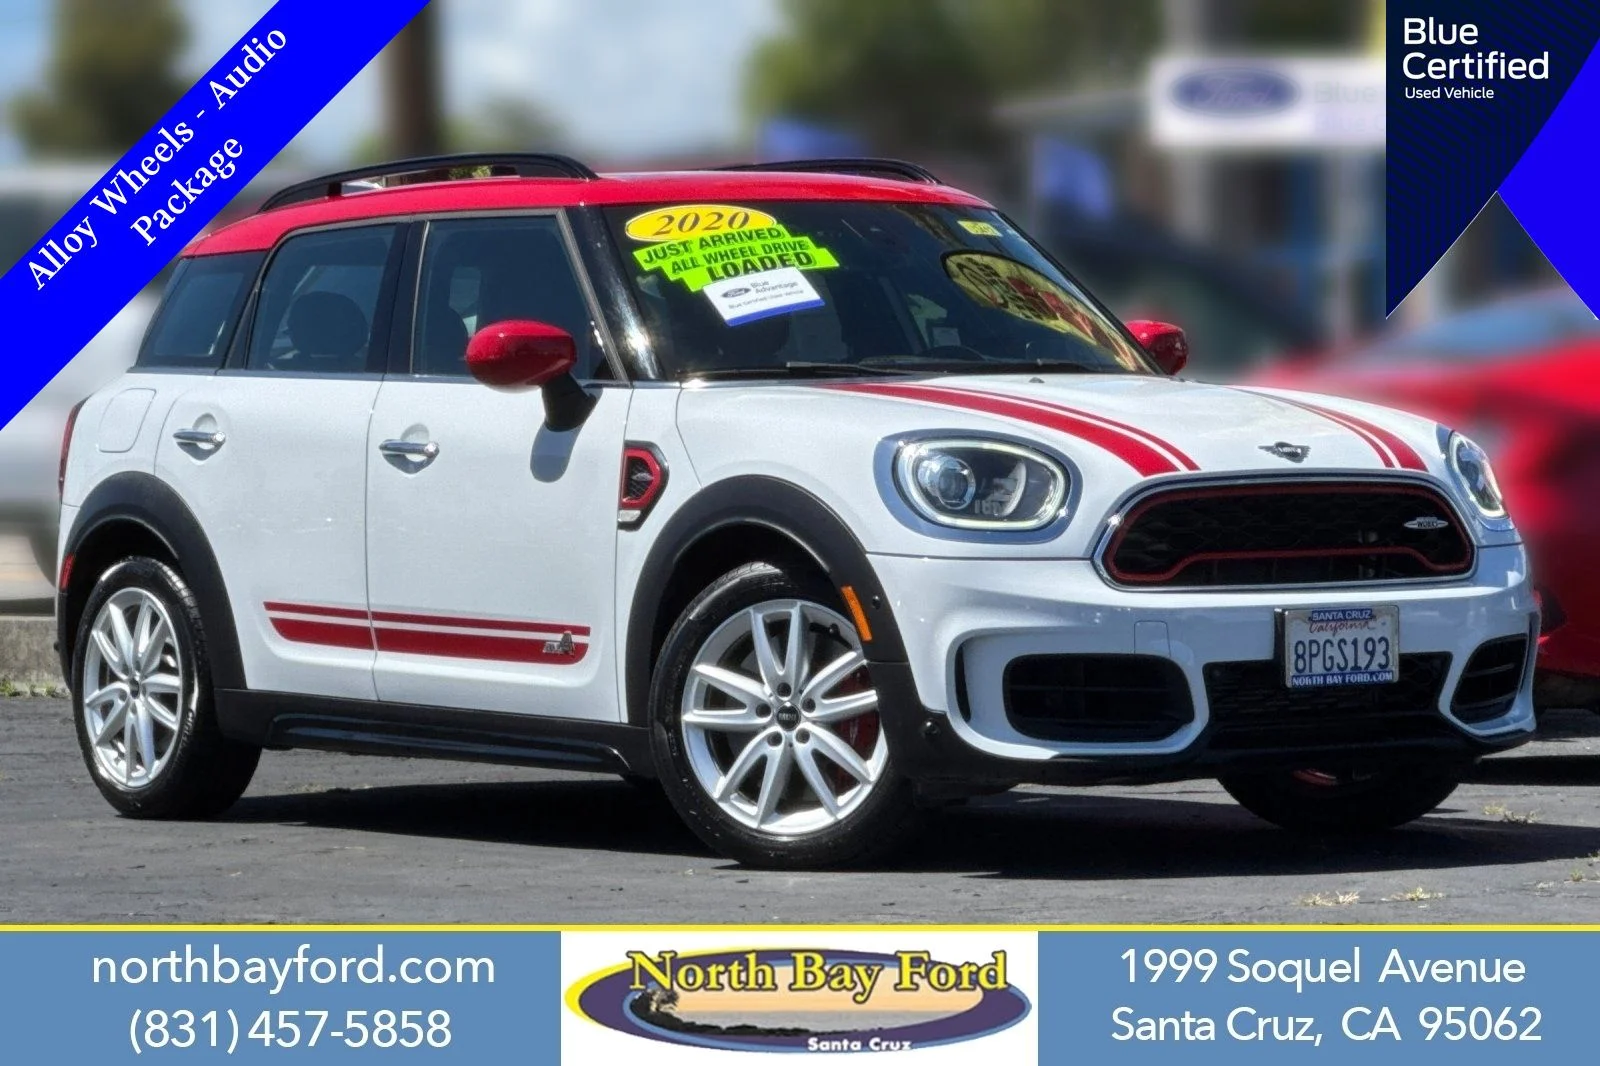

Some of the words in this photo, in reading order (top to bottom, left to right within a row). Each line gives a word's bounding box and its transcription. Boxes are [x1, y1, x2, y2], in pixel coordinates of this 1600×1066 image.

[653, 211, 750, 236] 2020
[643, 241, 690, 264] JUST
[699, 227, 782, 250] ARRIVED
[671, 258, 701, 275] ALL
[702, 246, 757, 266] WHEEL
[763, 239, 809, 255] DRIVE
[706, 251, 813, 281] LOADED
[1309, 620, 1375, 636] California
[1312, 610, 1344, 620] SANTA
[1345, 609, 1371, 619] CRUZ
[1294, 637, 1390, 673] 8PGS193
[1292, 675, 1324, 686] NORTH
[1326, 674, 1343, 684] BAY
[1345, 672, 1392, 683] FORD.COM
